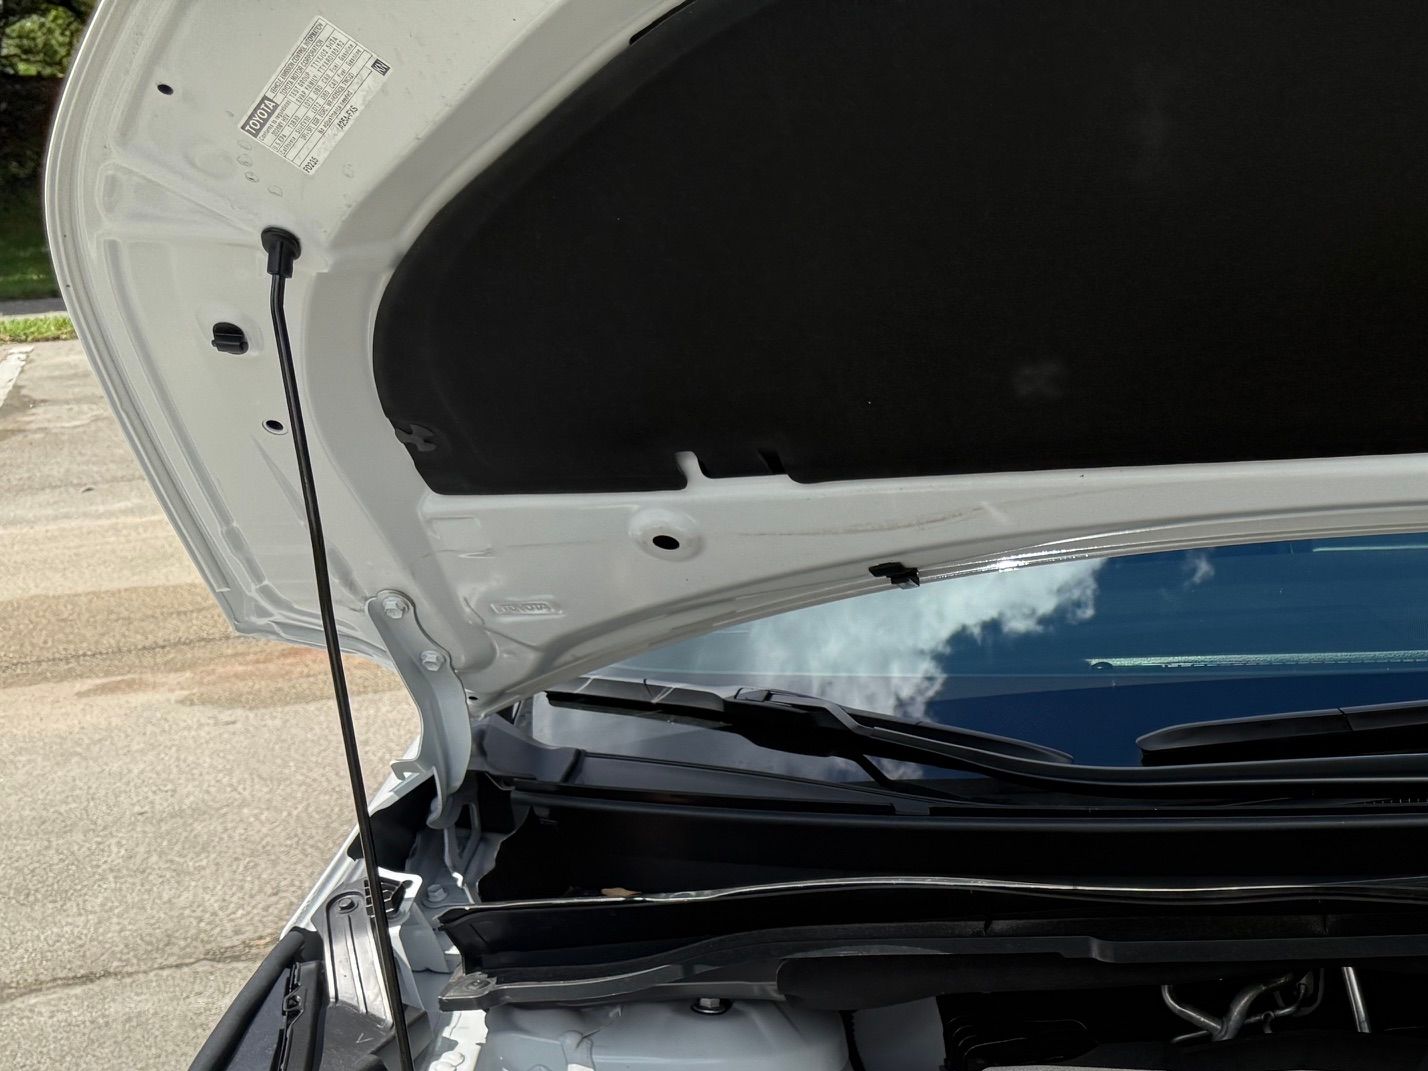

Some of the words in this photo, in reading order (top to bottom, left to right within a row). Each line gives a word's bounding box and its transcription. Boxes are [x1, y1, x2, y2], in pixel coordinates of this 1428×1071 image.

[269, 77, 284, 94] VEHICLE
[291, 45, 306, 63] CONTROL
[279, 79, 294, 95] TOYOTA
[290, 65, 304, 81] MOTOR
[300, 38, 324, 67] CORPORATION
[289, 86, 300, 98] TEST
[244, 97, 276, 135] TOYOTA
